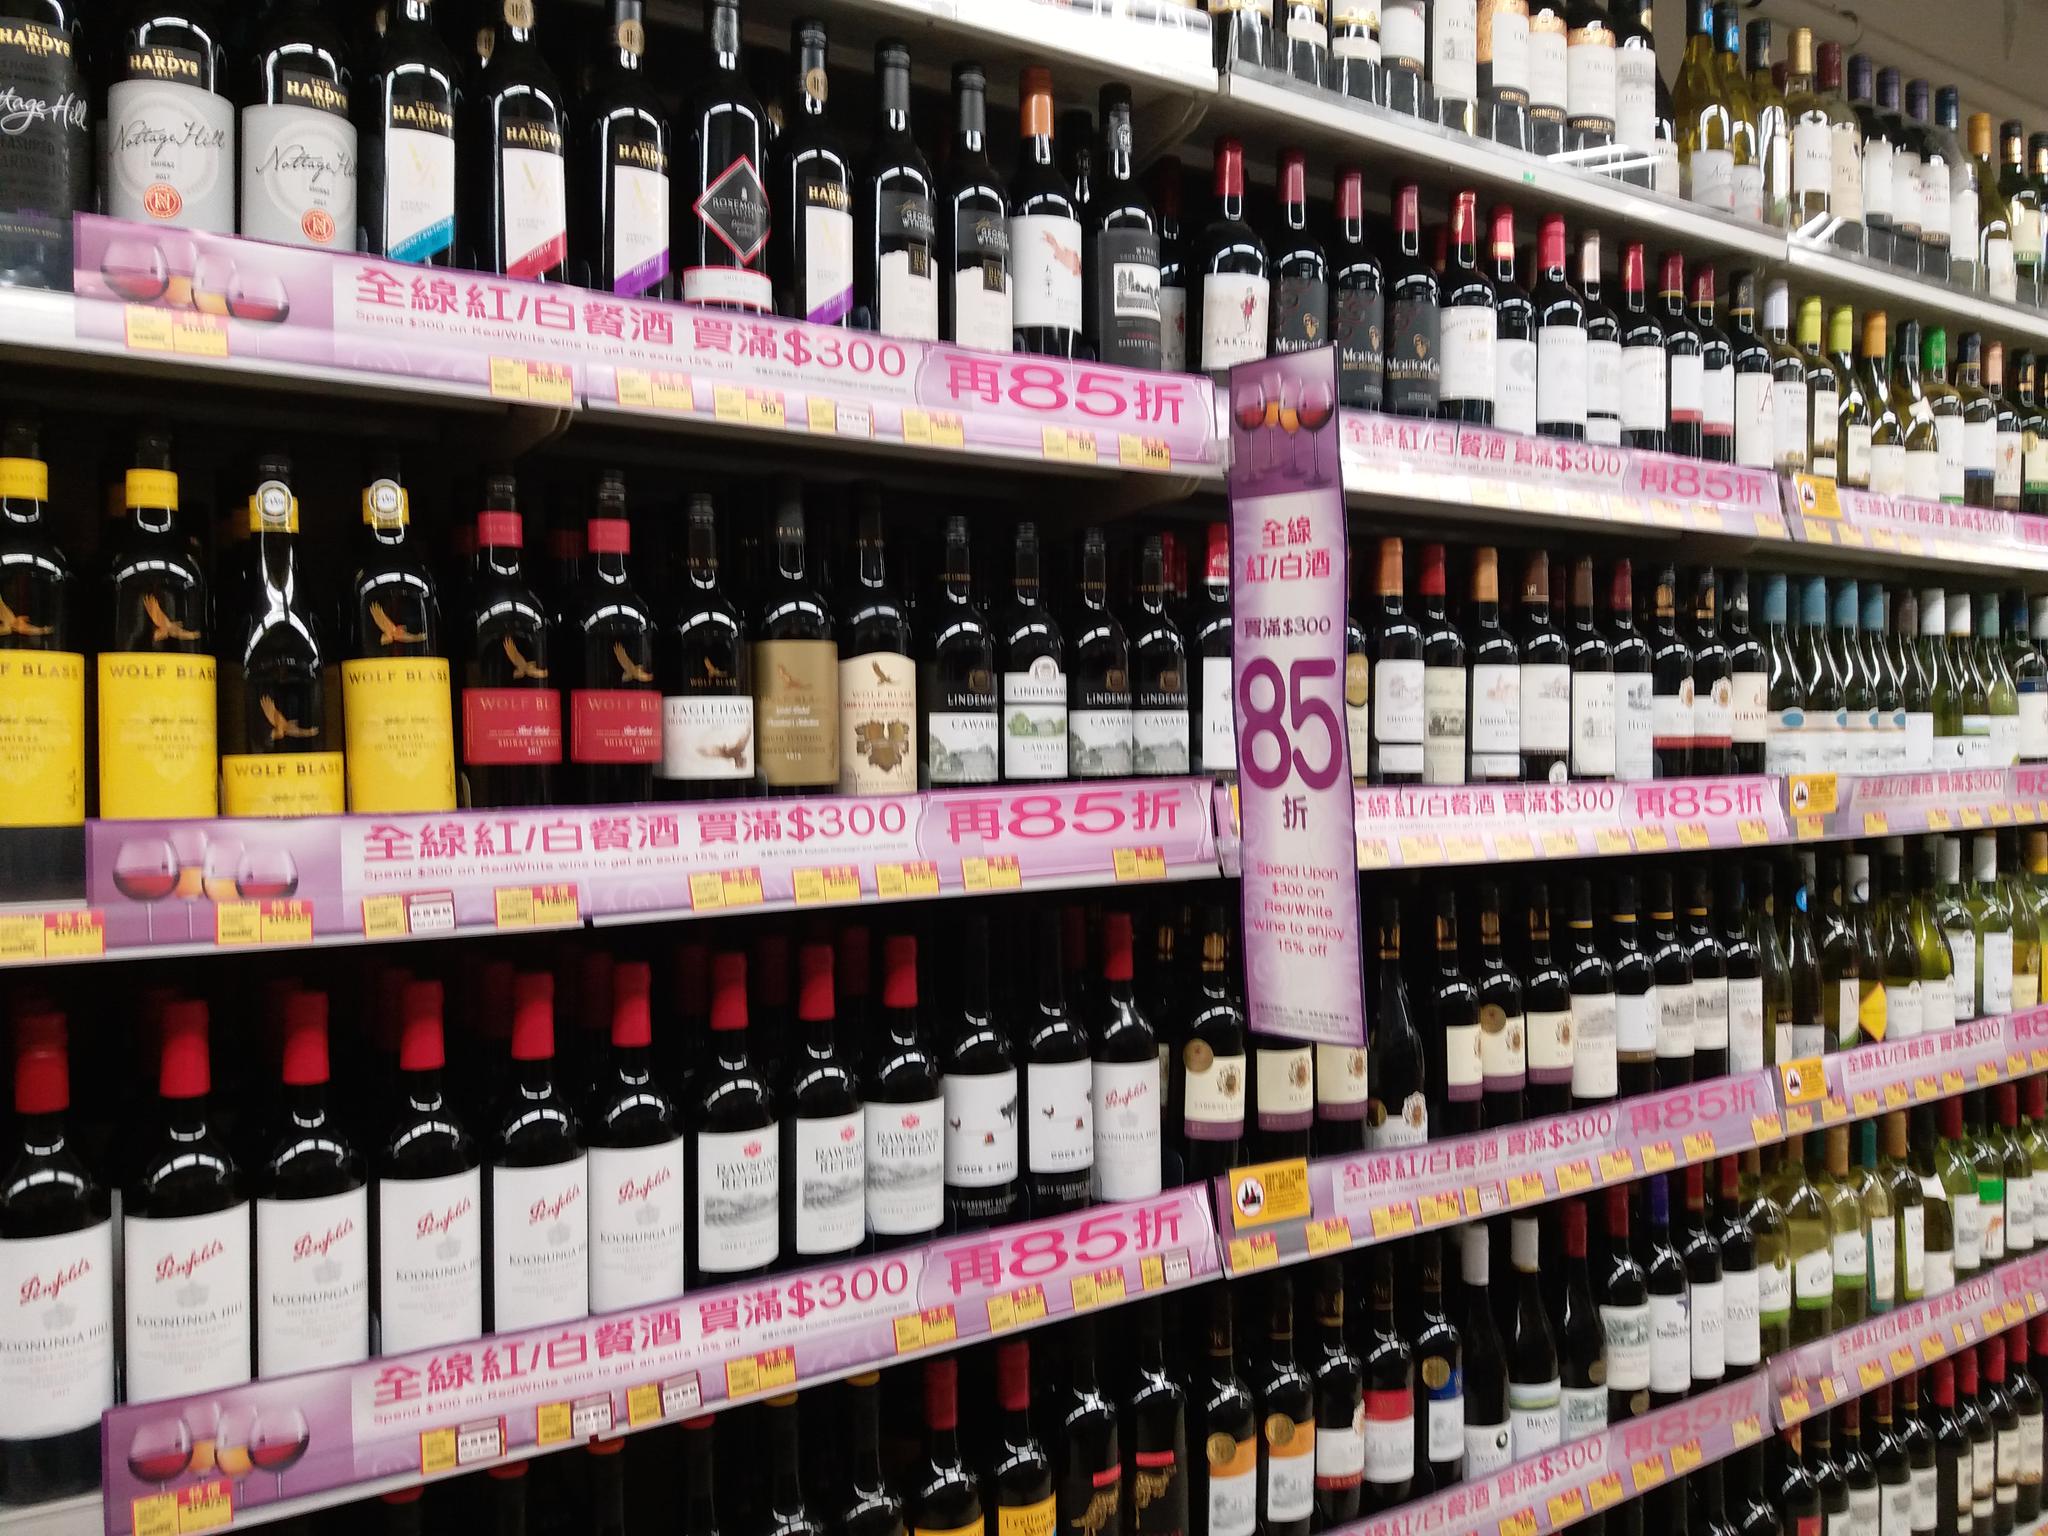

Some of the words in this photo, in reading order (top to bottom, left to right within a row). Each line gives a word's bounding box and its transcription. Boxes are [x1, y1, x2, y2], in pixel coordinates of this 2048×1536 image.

[0, 27, 71, 58] HARDYS
[130, 54, 199, 78] HARDYS
[51, 92, 88, 132] Hill
[393, 104, 453, 130] HARDYS
[114, 120, 186, 158] Nottage
[177, 121, 225, 149] Hill
[255, 145, 332, 183] Nottage
[356, 266, 673, 346] 全線紅/白餐酒
[692, 315, 906, 378] 買滿$300
[944, 354, 1184, 425] 再85折
[473, 327, 546, 347] Red/White
[550, 337, 582, 351] wine
[1514, 442, 1621, 479] 買滿$300
[1639, 460, 1764, 507] 再85折
[1262, 517, 1313, 551] 全線
[1246, 548, 1331, 585] 紅/白酒
[1243, 615, 1332, 642] 買滿$300
[109, 663, 170, 681] WOLF
[348, 670, 398, 686] WOLF
[480, 696, 530, 711] WOLF
[588, 697, 632, 711] WOLF
[1239, 656, 1344, 791] 85
[234, 763, 288, 778] WOLF
[1281, 793, 1309, 832] 折
[1502, 787, 1615, 816] 買滿$300
[1633, 783, 1764, 821] 再85折
[364, 814, 681, 863] 全線紅/白餐酒
[697, 801, 907, 846] 買滿$300
[943, 788, 1182, 845] 再85折
[480, 858, 554, 875] Red/White
[557, 858, 590, 871] wine
[1256, 861, 1300, 879] Spend
[1303, 863, 1340, 884] Upon
[1271, 881, 1304, 898] $300
[1307, 885, 1326, 899] on
[1263, 900, 1333, 921] Red/White
[1253, 920, 1287, 935] wine
[1290, 922, 1304, 935] to
[1307, 924, 1346, 944] enjoy
[1278, 940, 1305, 956] 15%
[1309, 943, 1329, 959] off
[1507, 1112, 1613, 1156] 買滿$300
[1629, 1080, 1758, 1140] 再85折
[618, 1165, 671, 1206] Penfolds
[416, 1196, 473, 1241] Penfolds
[529, 1183, 581, 1226] Penfolds
[292, 1217, 355, 1263] Penfolds
[155, 1238, 225, 1283] Penfolds
[19, 1257, 94, 1307] Penfolds
[374, 1307, 683, 1408] 全線紅/白餐酒
[698, 1257, 910, 1335] 買滿$300
[943, 1200, 1184, 1297] 再85折
[487, 1380, 559, 1403] Red/White
[562, 1371, 595, 1387] wine
